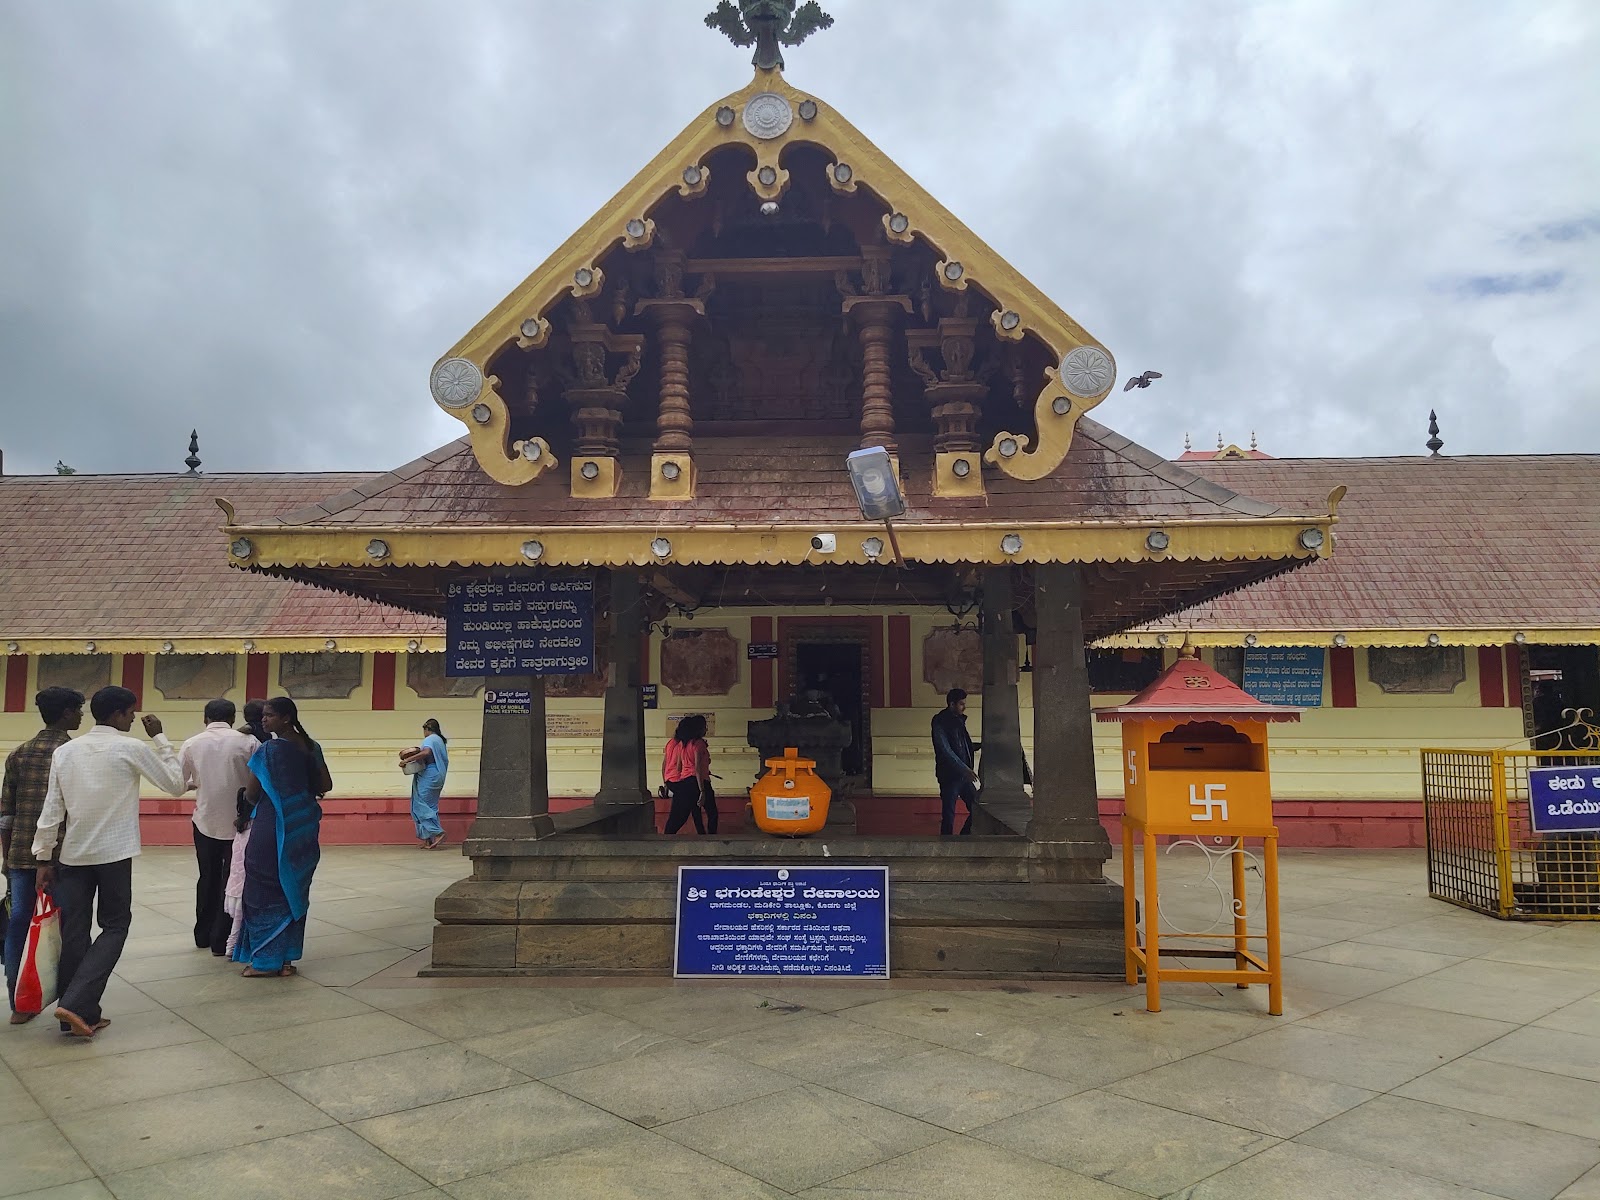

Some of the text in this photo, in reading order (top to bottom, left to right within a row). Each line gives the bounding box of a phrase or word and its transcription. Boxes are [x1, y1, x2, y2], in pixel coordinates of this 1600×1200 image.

[448, 580, 592, 598] ಶ್ರೀ ಕ್ಷೇತ್ರದಲ್ಲಿ ದೇವರಿಗೆ ಅರ್ಪಿಸುವ
[464, 601, 487, 612] ಹರಕೆ
[527, 600, 577, 614] ವಸ್ತುಗಳನ್ನು
[463, 618, 582, 634] ಹುಂಡಿಯಲ್ಲಿ ಹಾಕುವುದರಿಂದ
[458, 640, 480, 655] ನಿಮ್ಮ
[456, 656, 588, 673] ದೇವರ ಕೃಪೆಗೆ ಪಾತ್ರರಾಗುತ್ತೀರಿ
[1548, 799, 1600, 816] ಒಡೆಯು
[687, 886, 880, 902] ಶ್ರೀ ಭಗಂಡೇಶ್ವರ ದೇವಾಲಯ
[844, 902, 857, 911] ಜಿಲ್ಲೆ
[747, 912, 817, 921] ಭಕ್ತಾದಿಗಳಲ್ಲಿ ವಿನಂತಿ
[751, 924, 775, 933] ಹೆಸರಿನಲ್ಲಿ
[832, 924, 851, 932] ಅಥವಾ
[794, 934, 807, 944] ಸಂಸ್ಥೆ
[735, 944, 764, 953] ಭಕ್ತಾದಿಗಳು
[735, 954, 770, 964] ದೇಣಿಗೆಗಳನ್ನು
[783, 964, 822, 974] ಪಡೆದುಕೊಳ್ಳಲು
